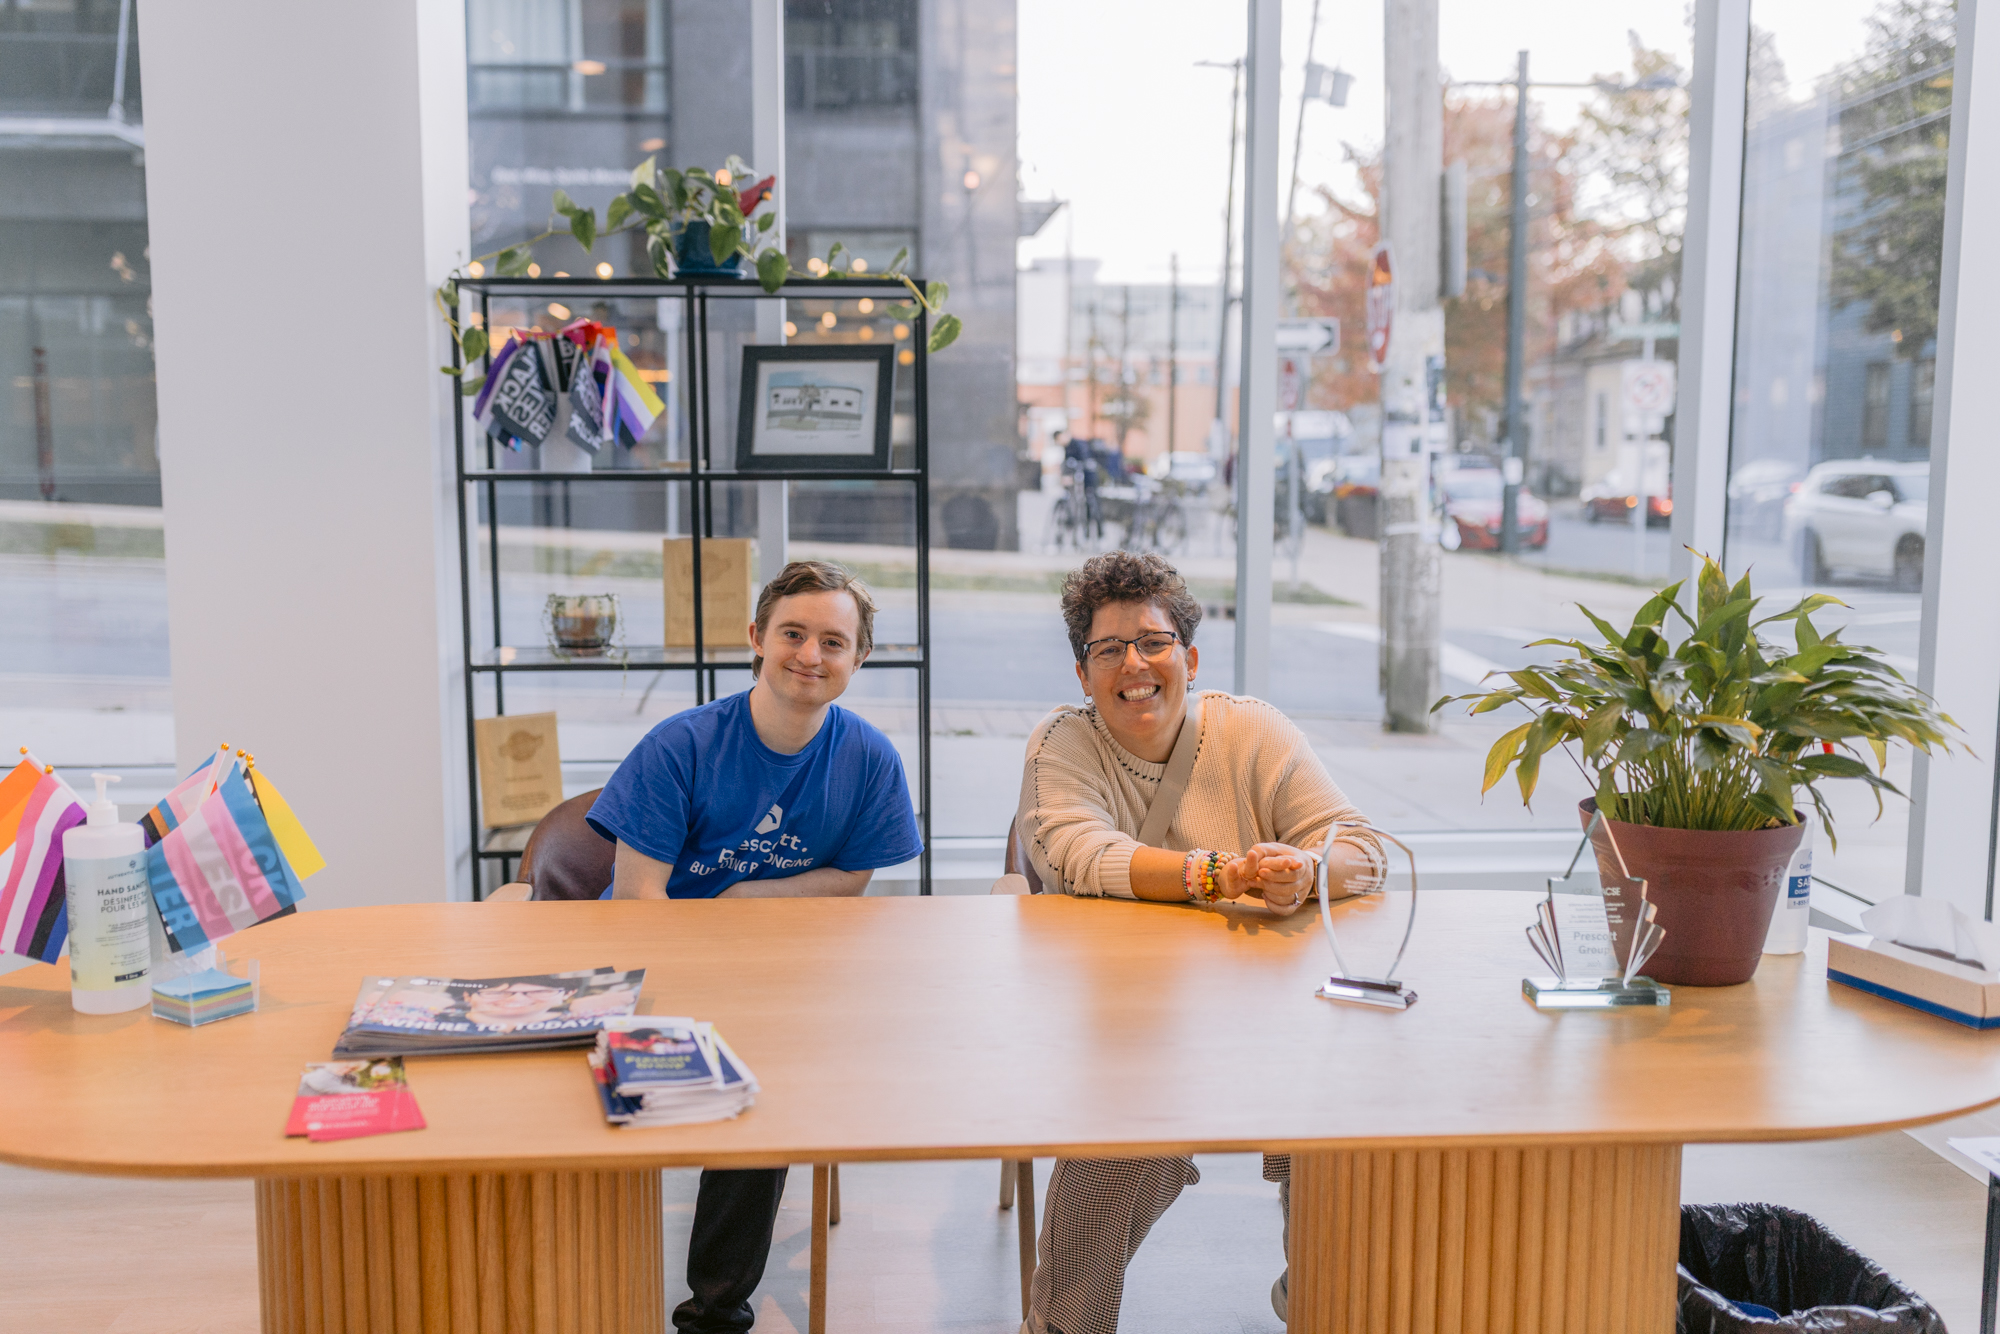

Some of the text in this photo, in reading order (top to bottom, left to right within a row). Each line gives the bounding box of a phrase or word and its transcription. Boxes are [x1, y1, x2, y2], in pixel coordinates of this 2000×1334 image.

[717, 833, 808, 863] pesctt.
[689, 857, 748, 876] BUDING
[97, 886, 125, 896] HAND
[100, 904, 126, 914] POUR
[127, 900, 140, 910] LES
[1573, 931, 1618, 941] Prescott
[382, 1017, 469, 1032] WHERE
[475, 1022, 508, 1032] TO
